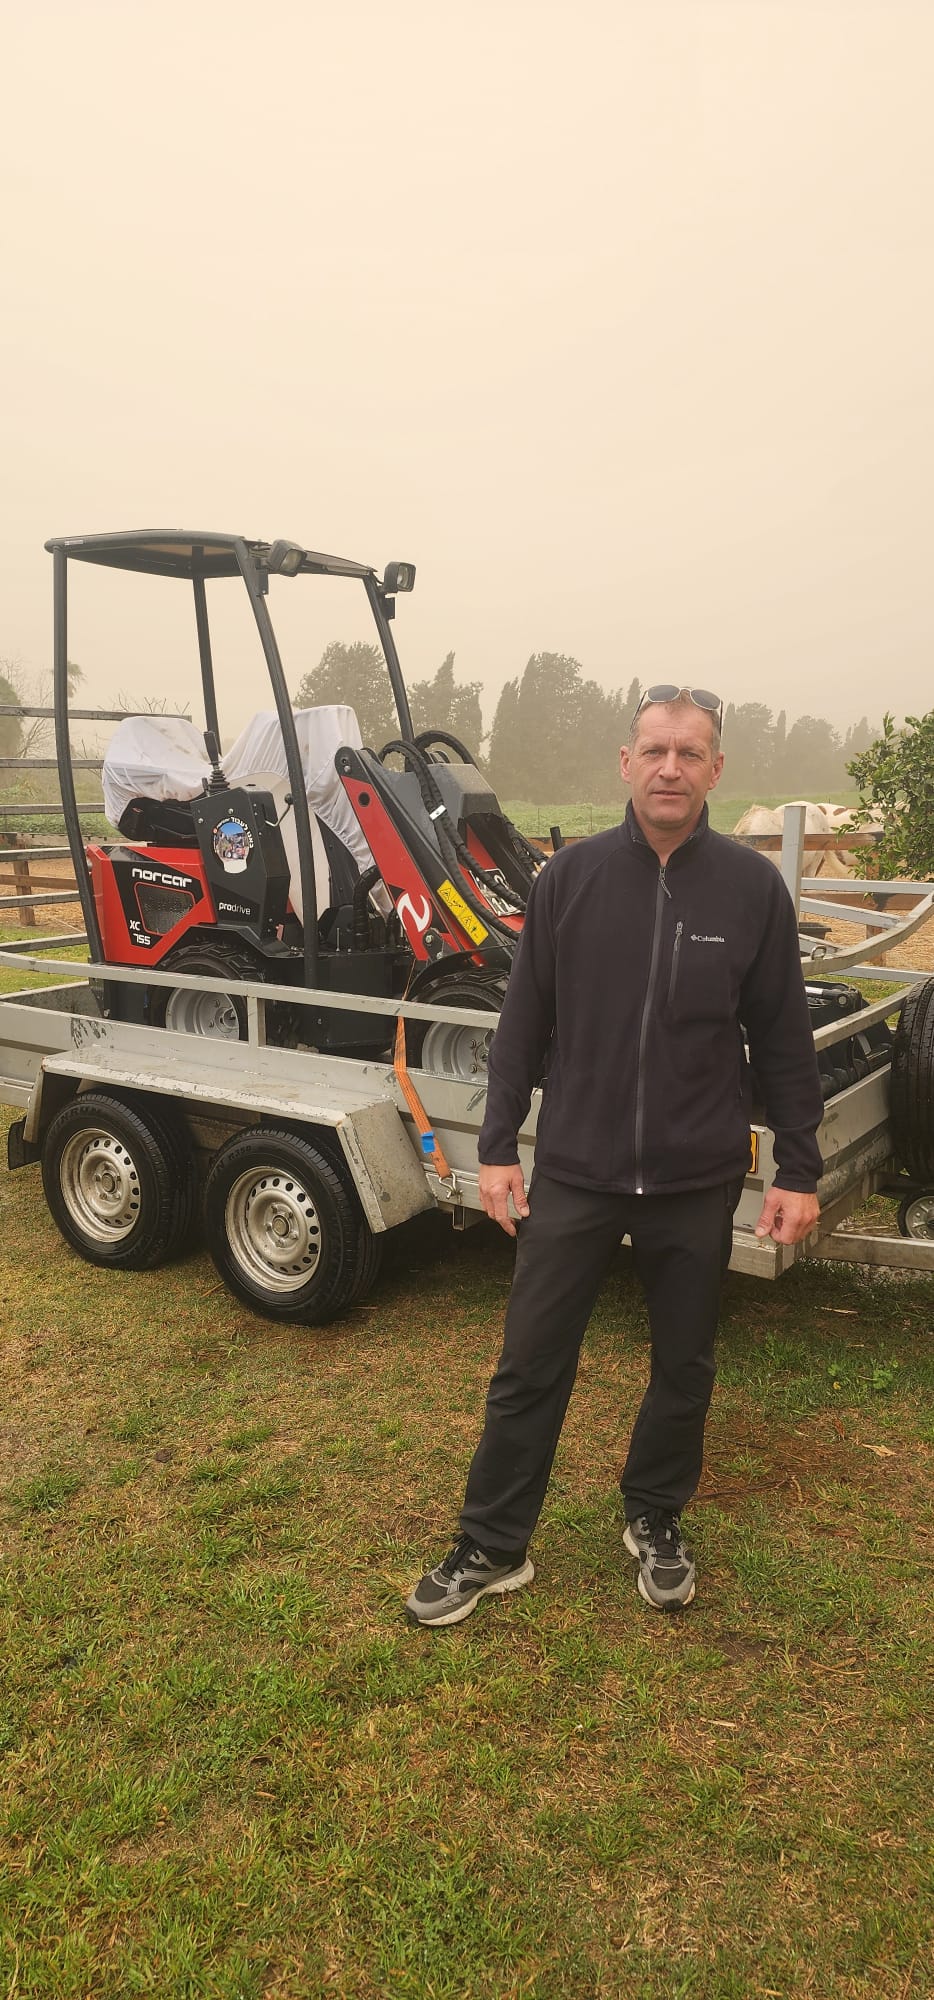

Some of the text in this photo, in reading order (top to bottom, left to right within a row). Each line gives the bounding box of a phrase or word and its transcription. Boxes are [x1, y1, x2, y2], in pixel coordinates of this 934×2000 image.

[131, 867, 193, 888] norcar
[218, 902, 251, 915] prodrive
[129, 919, 141, 931] XC
[132, 933, 151, 946] 755
[697, 935, 725, 943] Columbia
